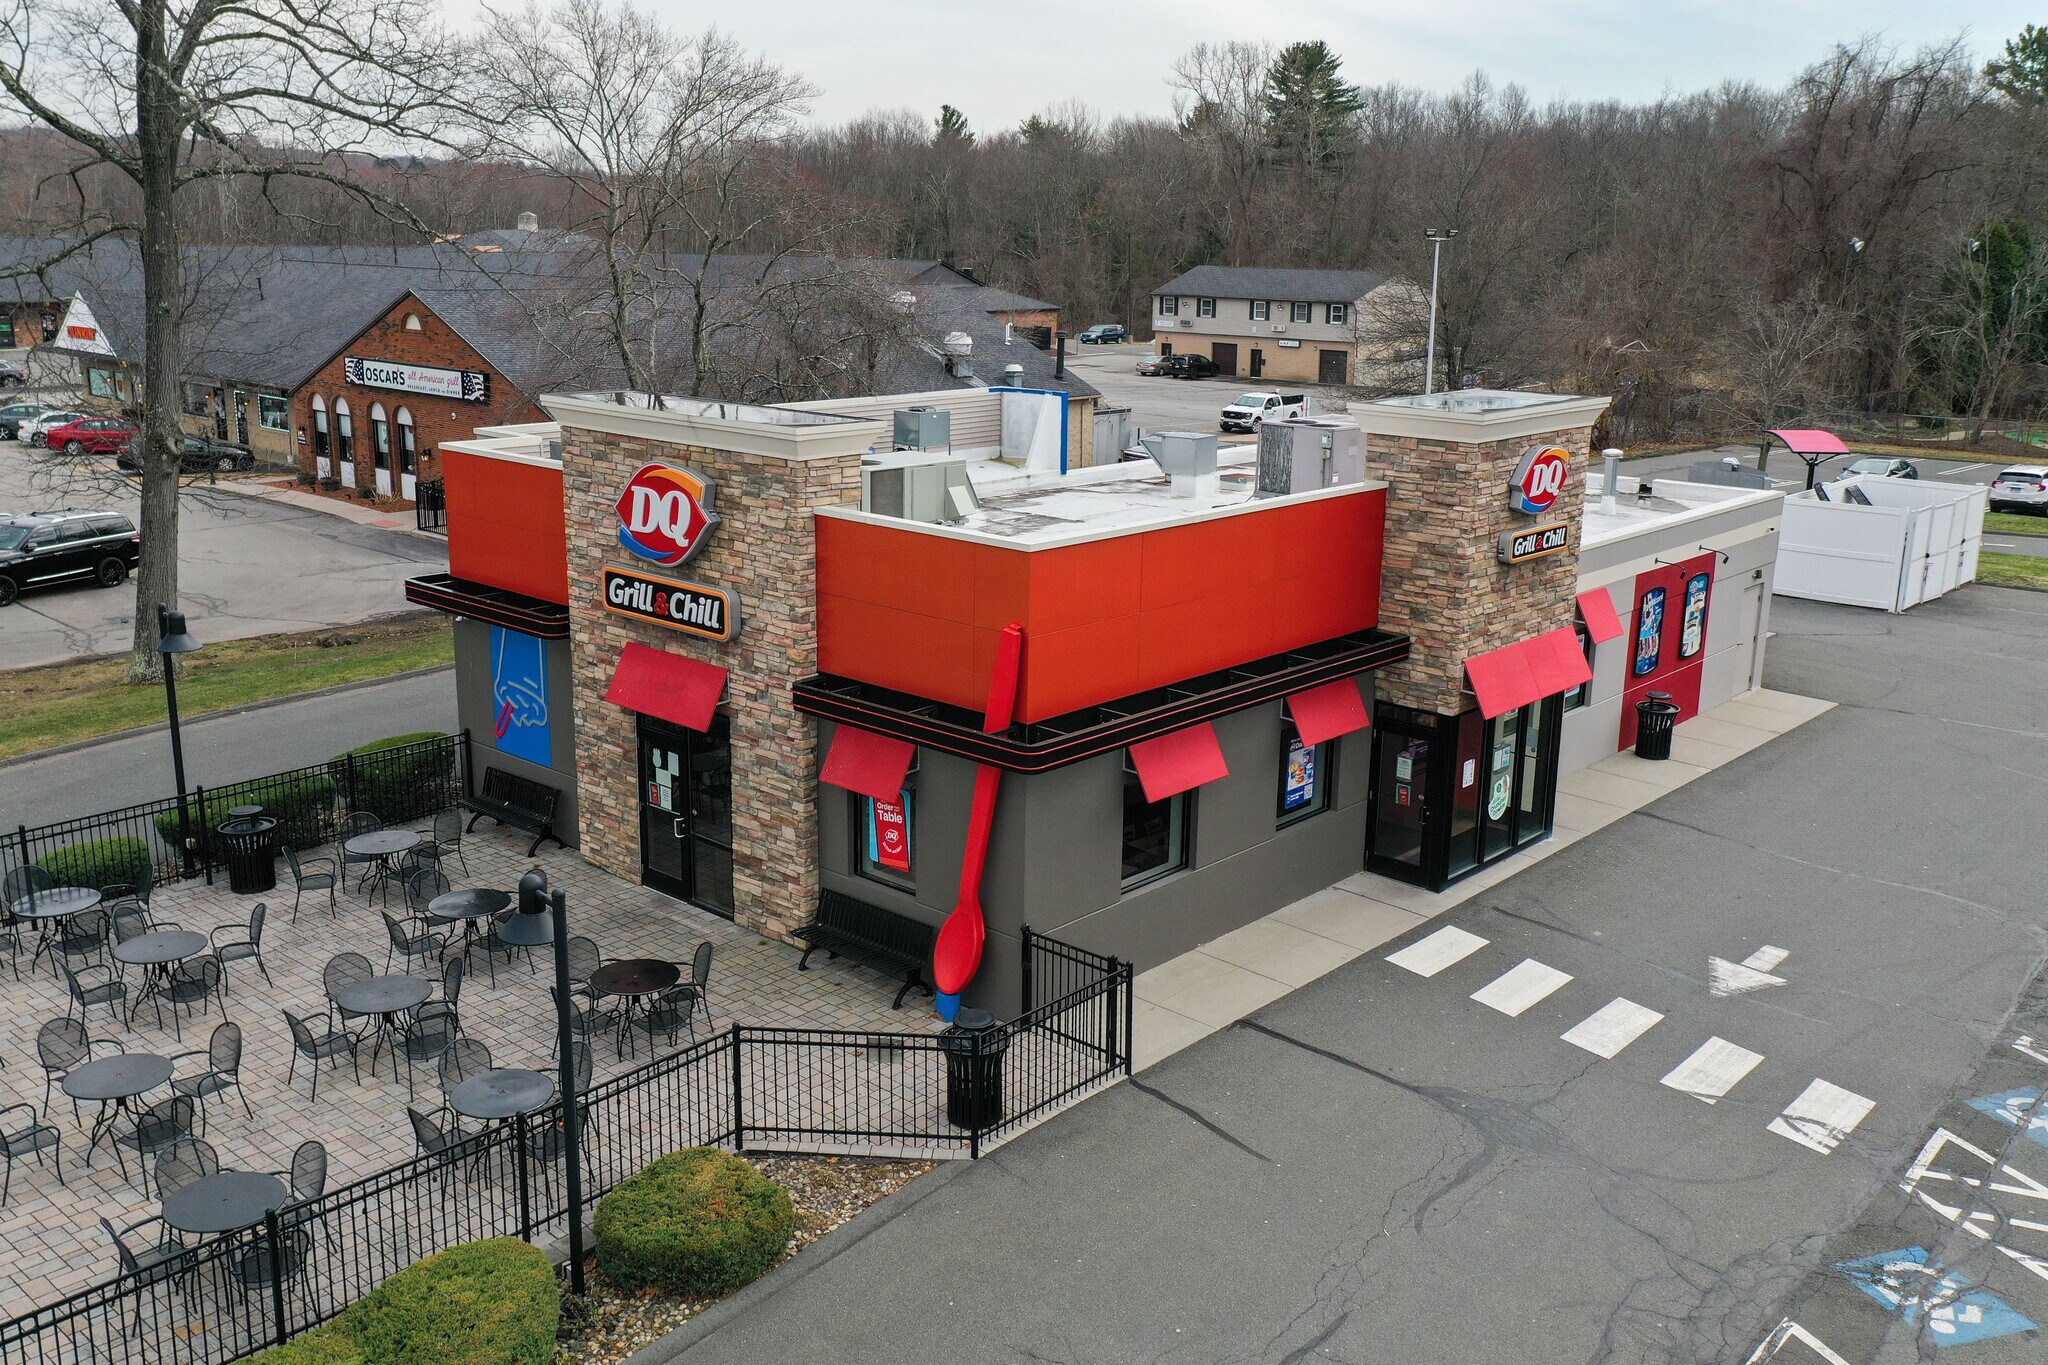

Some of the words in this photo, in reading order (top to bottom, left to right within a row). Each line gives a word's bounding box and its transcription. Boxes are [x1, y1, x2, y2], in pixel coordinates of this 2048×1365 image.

[408, 371, 417, 380] all
[418, 372, 445, 385] American
[446, 376, 460, 389] grill
[1529, 460, 1563, 498] DQ
[629, 485, 691, 548] DQ
[877, 802, 893, 811] Order
[877, 810, 903, 823] Table
